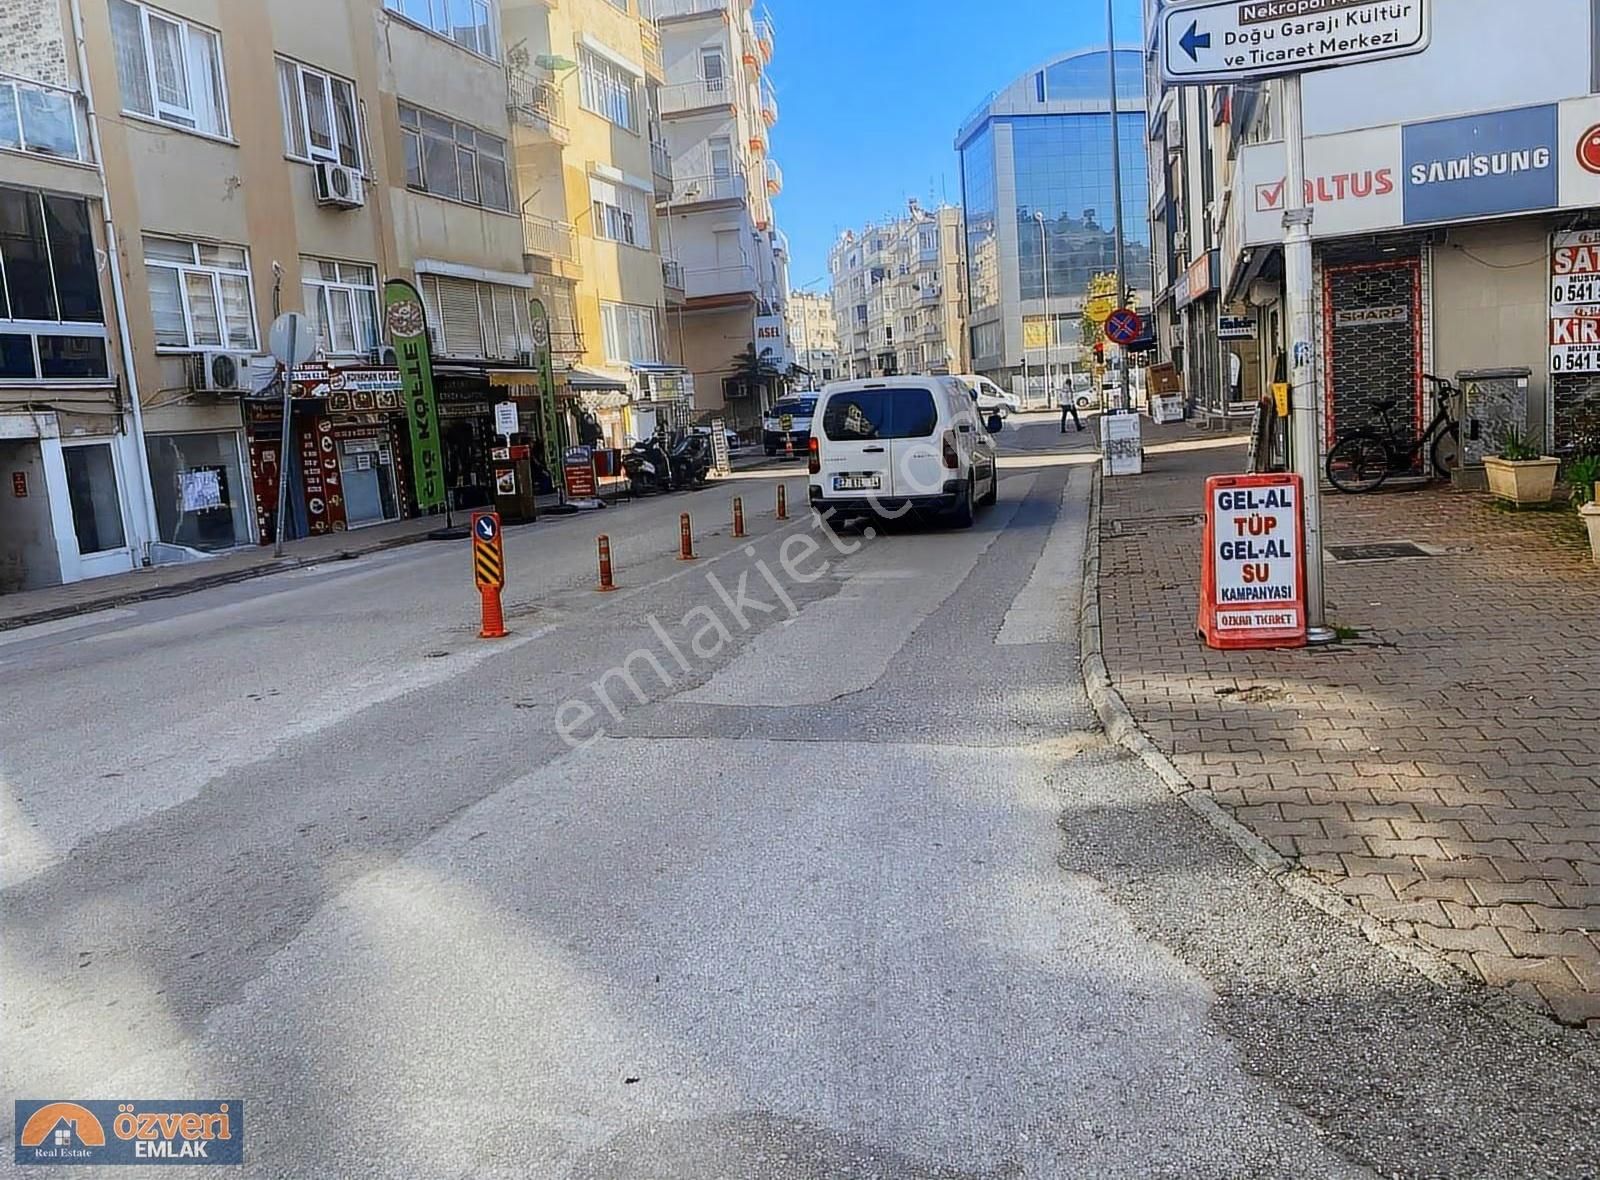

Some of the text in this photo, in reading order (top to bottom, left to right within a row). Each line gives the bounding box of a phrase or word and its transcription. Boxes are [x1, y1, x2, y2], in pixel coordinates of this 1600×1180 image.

[1224, 4, 1411, 46] Doğu Garajı Kültür
[1224, 28, 1398, 66] ve Ticaret Merkezi
[1411, 148, 1550, 186] SAMSUNG
[1554, 285, 1563, 302] 0
[1567, 283, 1592, 301] 541
[1339, 308, 1404, 321] SHARP
[758, 326, 780, 338] ASEL
[1553, 354, 1561, 371] 0
[1566, 353, 1590, 370] 541
[1218, 488, 1292, 511] GEL-AL
[1234, 513, 1276, 536] TÜP
[1219, 539, 1291, 560] GEL-AL
[1242, 563, 1269, 583] SU
[1221, 585, 1292, 601] KAMPANYASI
